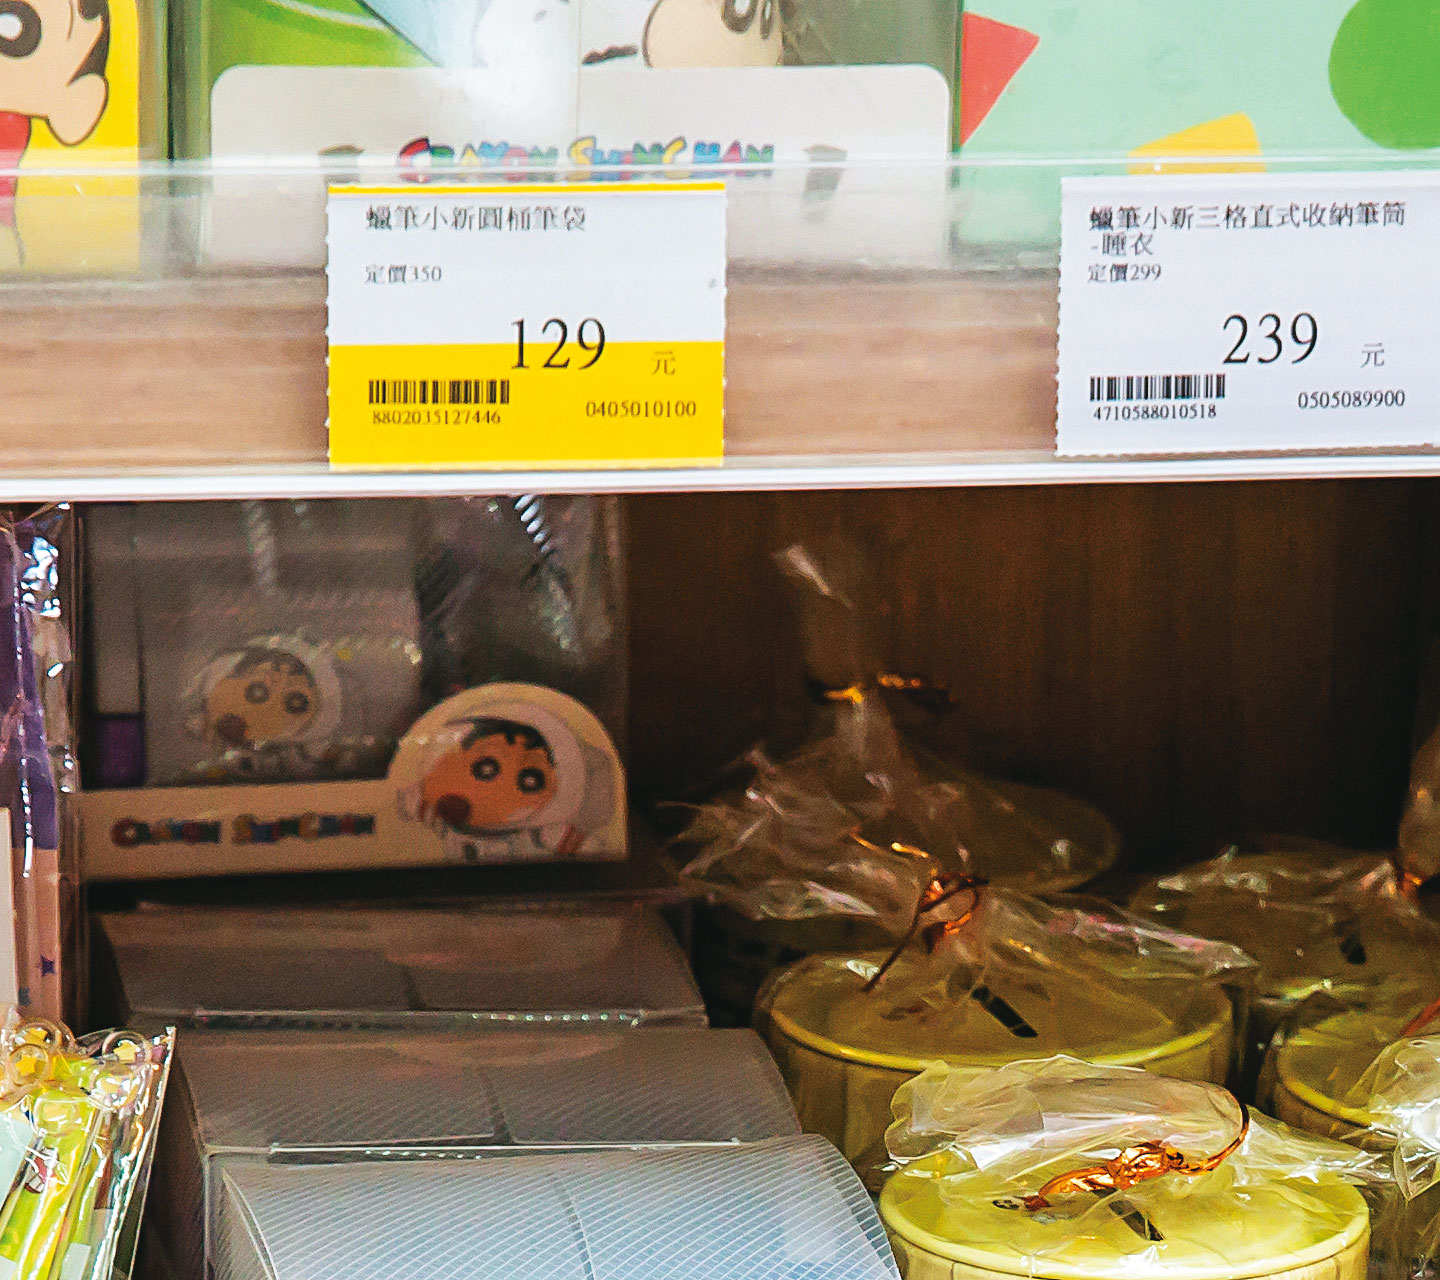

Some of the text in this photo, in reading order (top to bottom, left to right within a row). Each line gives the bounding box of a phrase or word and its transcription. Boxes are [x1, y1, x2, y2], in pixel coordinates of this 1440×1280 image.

[510, 318, 677, 376] 129 元
[1222, 312, 1386, 367] 239 元
[586, 399, 697, 420] 0405010100
[1298, 390, 1406, 411] 0505089900
[1093, 403, 1217, 421] 4710588010518
